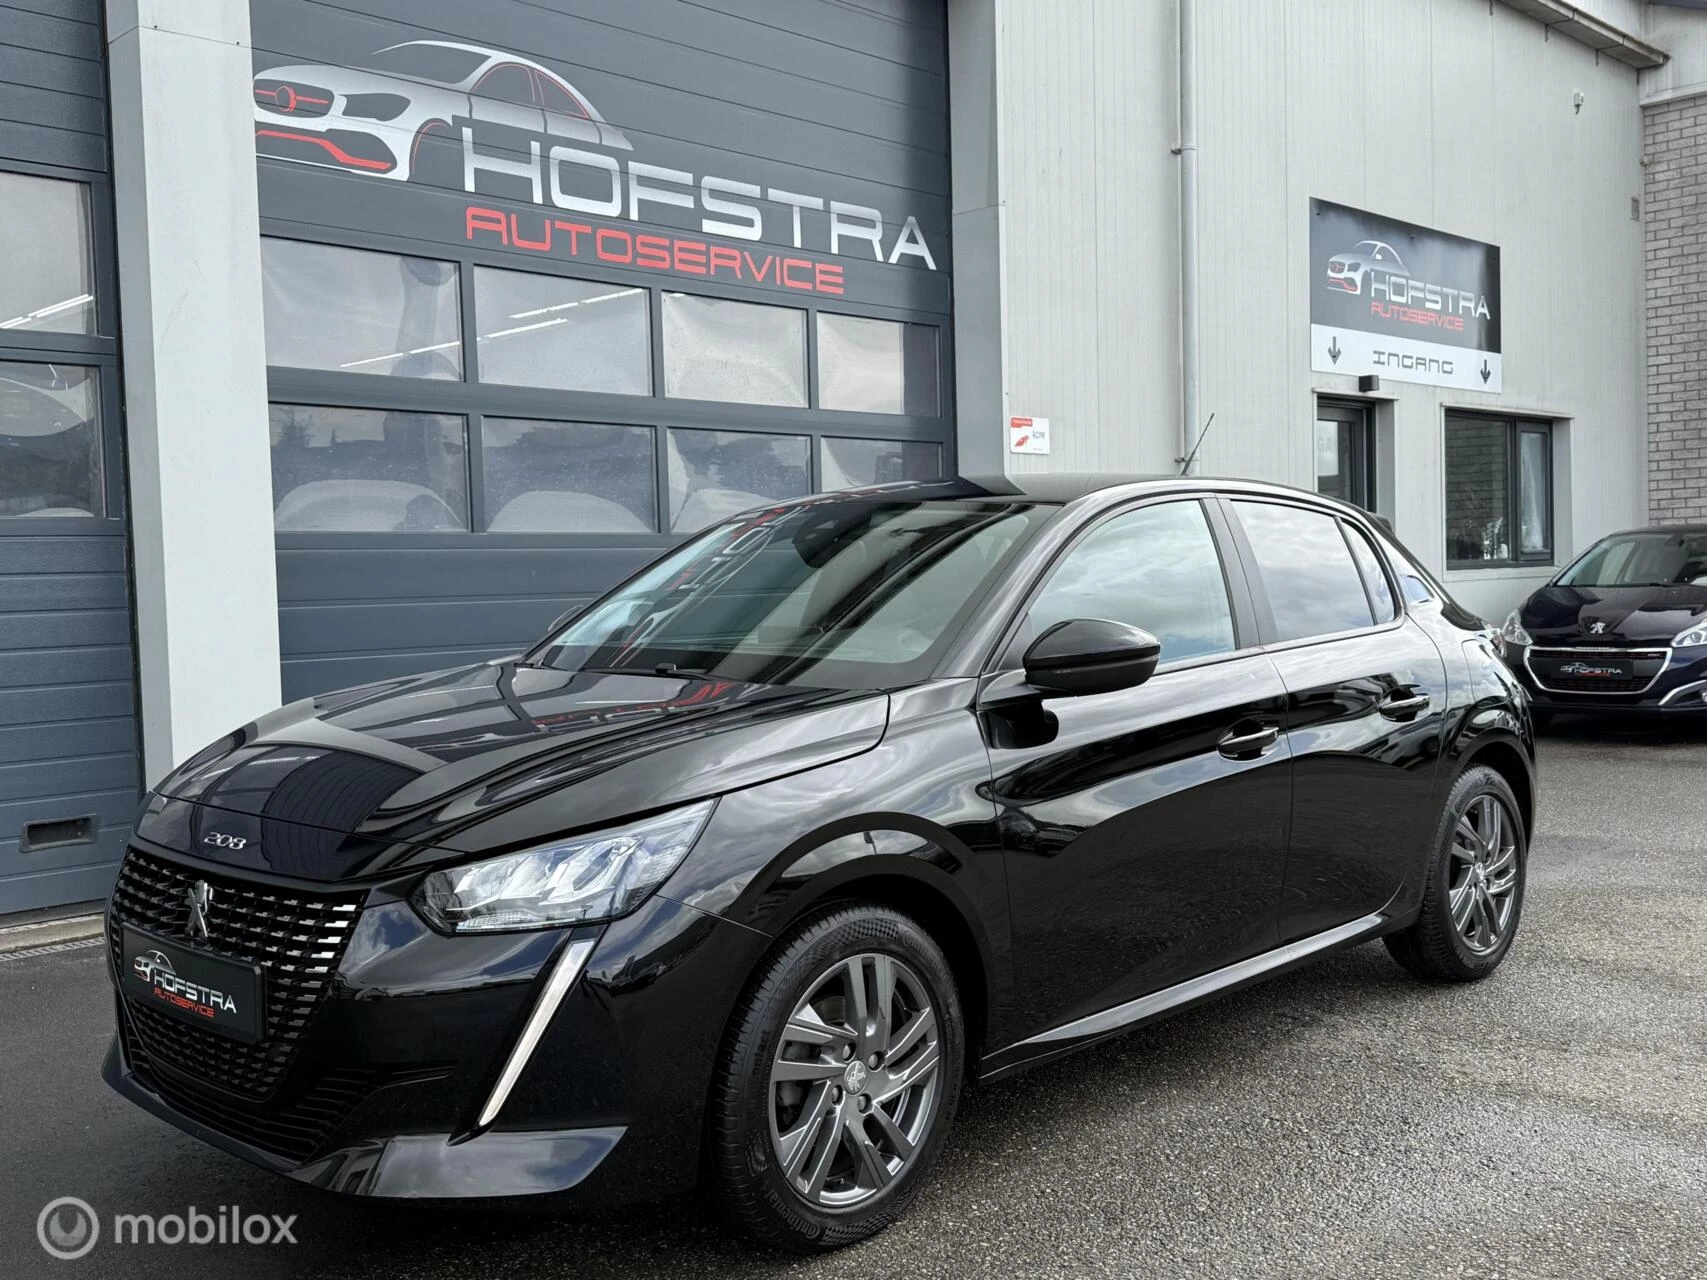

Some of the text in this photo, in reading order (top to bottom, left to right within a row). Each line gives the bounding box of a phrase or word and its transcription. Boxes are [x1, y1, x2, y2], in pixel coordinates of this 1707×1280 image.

[462, 127, 937, 270] HOFSTRA
[466, 207, 844, 294] AUTOSERVICE
[1371, 271, 1491, 320] HOFSTRA
[1371, 301, 1464, 331] AUTOSERVICE
[1373, 350, 1454, 375] INGANG
[204, 832, 247, 850] 208
[154, 968, 237, 1014] HOFSTRA
[154, 987, 215, 1018] AUTOSERVICE
[764, 1188, 820, 1239] Continental
